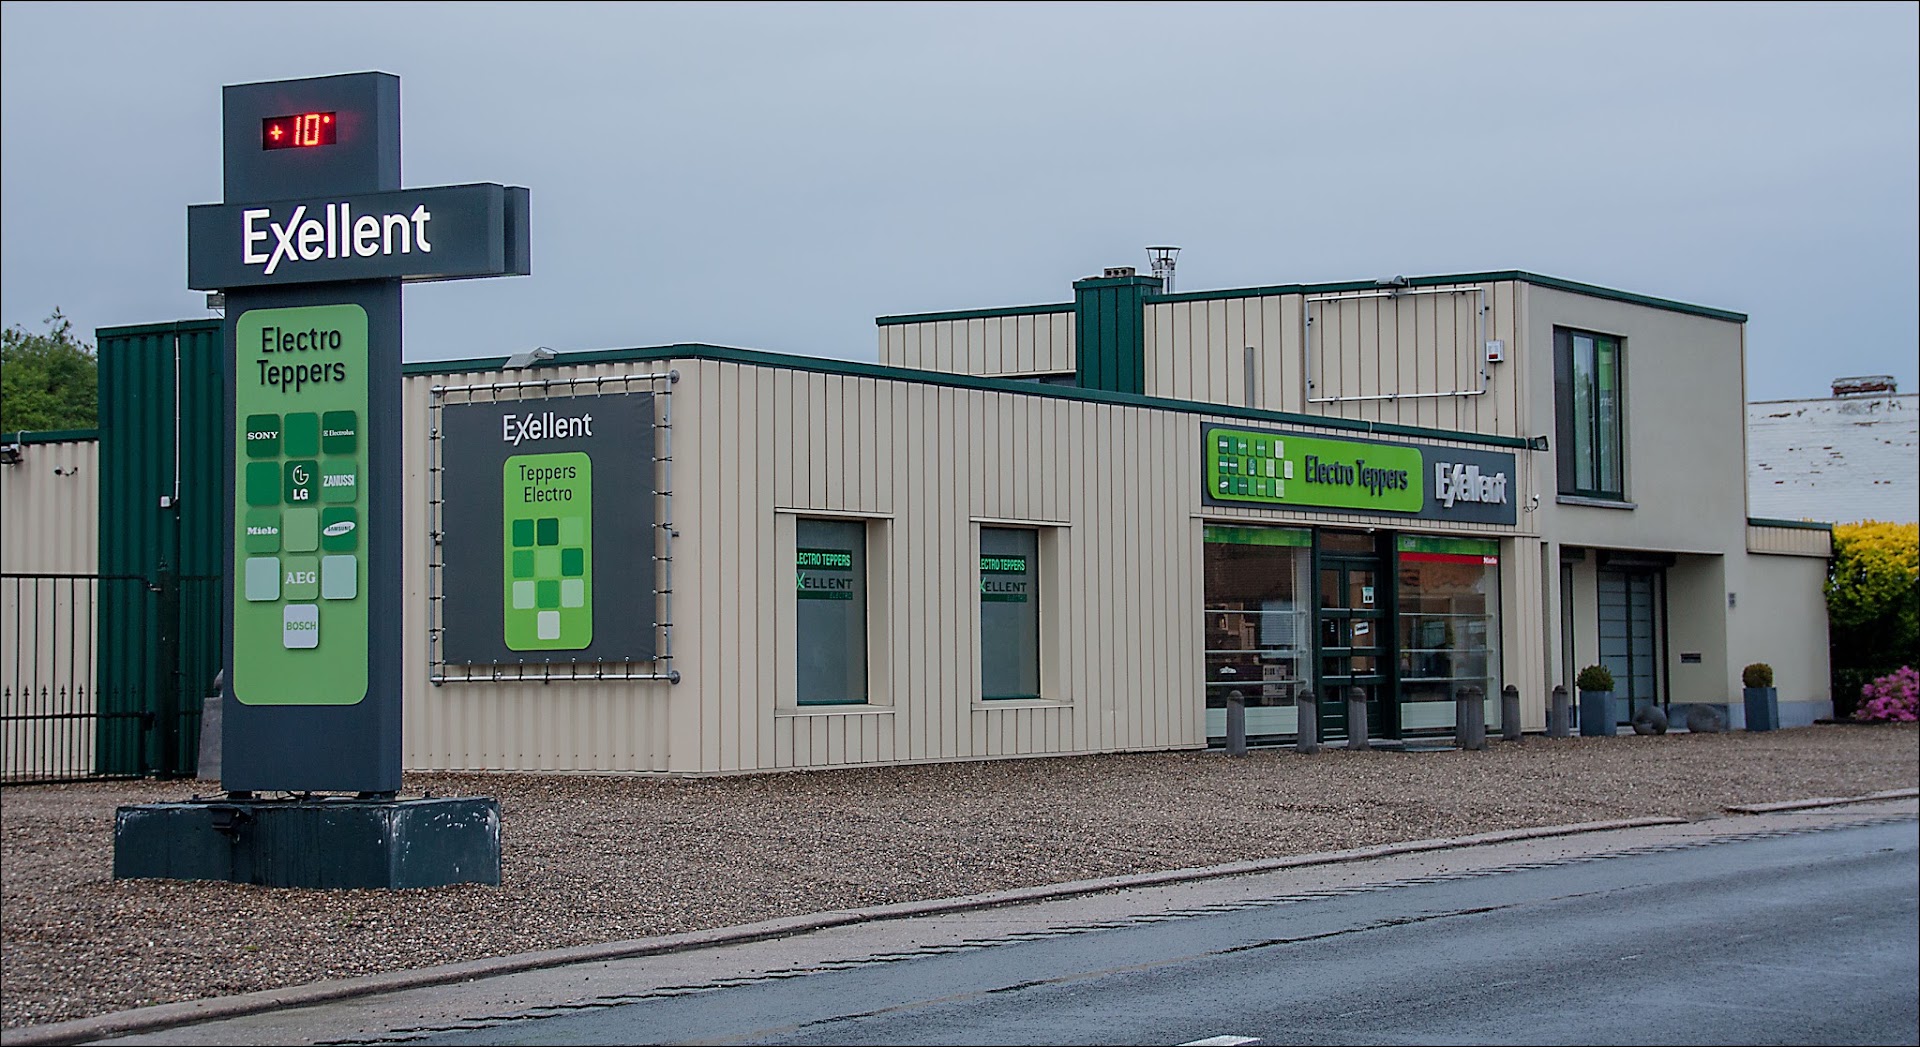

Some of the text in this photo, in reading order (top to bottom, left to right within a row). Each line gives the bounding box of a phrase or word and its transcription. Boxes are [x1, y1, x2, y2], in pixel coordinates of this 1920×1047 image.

[243, 202, 432, 275] Exellent
[262, 326, 341, 353] Electro
[256, 359, 346, 393] Teppers
[247, 431, 279, 441] SONY
[503, 411, 593, 446] Exellent
[323, 474, 355, 488] ZANUSSI
[519, 464, 577, 485] Teppers
[1305, 454, 1409, 497] Electro Teppers
[1435, 461, 1508, 508] Exellent
[293, 488, 309, 501] LG
[523, 486, 573, 503] Electro
[246, 526, 279, 536] Miele
[821, 553, 851, 567] TEPPERS
[1000, 558, 1025, 571] TEPPERS
[285, 571, 317, 585] AEG
[286, 621, 317, 631] BOSCH
